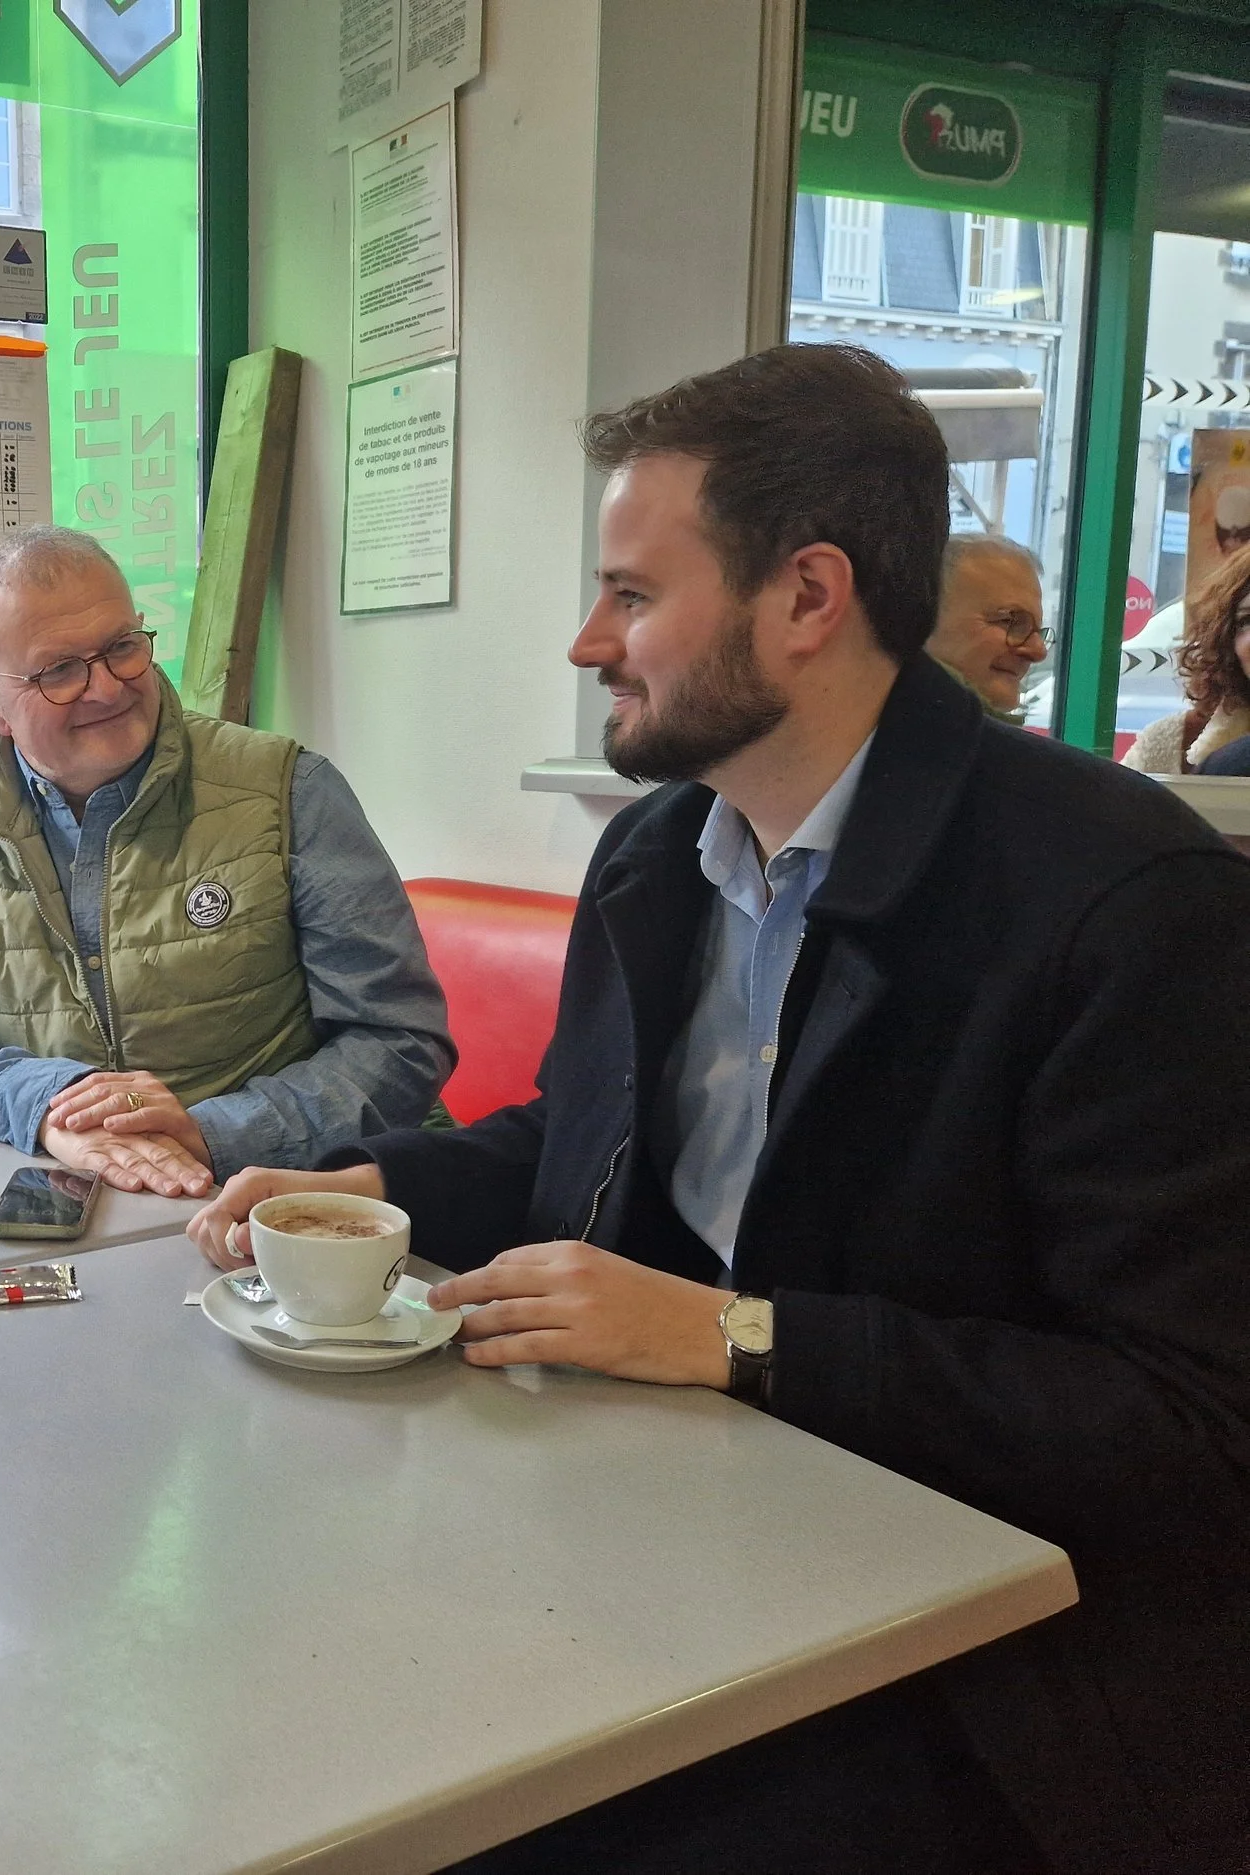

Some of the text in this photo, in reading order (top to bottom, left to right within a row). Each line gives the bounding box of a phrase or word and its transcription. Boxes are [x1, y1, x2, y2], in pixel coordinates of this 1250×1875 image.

[800, 90, 858, 138] JEU
[364, 411, 441, 436] Interdiction de vente
[358, 424, 446, 452] de tabac et de produits
[354, 439, 449, 466] de vapotage aux mineurs
[365, 456, 437, 478] de moins de 18 ans
